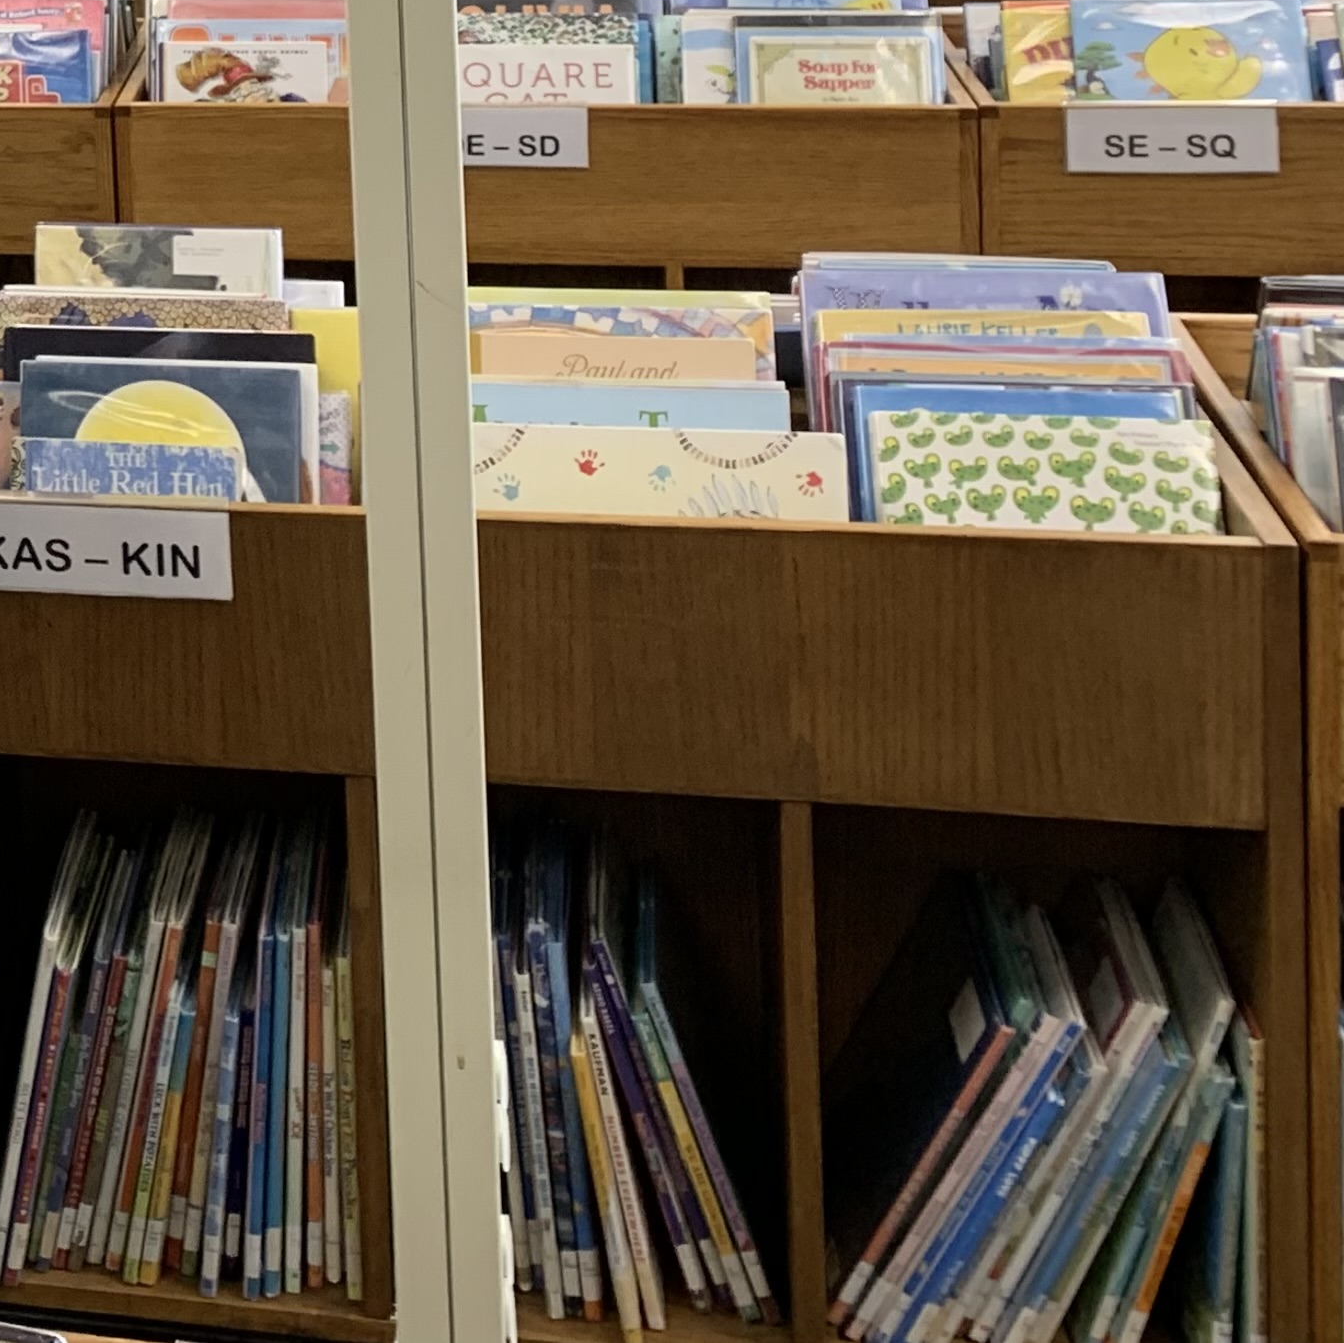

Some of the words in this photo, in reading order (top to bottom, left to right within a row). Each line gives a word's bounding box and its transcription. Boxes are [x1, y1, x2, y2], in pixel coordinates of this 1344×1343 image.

[463, 62, 614, 88] QUARE
[798, 59, 848, 77] Soap
[463, 134, 485, 157] E
[518, 134, 560, 157] SD
[1104, 134, 1149, 158] SE
[1186, 134, 1238, 159] SQ
[107, 451, 147, 469] THE
[31, 466, 102, 494] Little
[112, 470, 160, 496] Red
[170, 472, 224, 498] Hen
[121, 541, 201, 580] KIN
[586, 1032, 611, 1097] KAUFMAN
